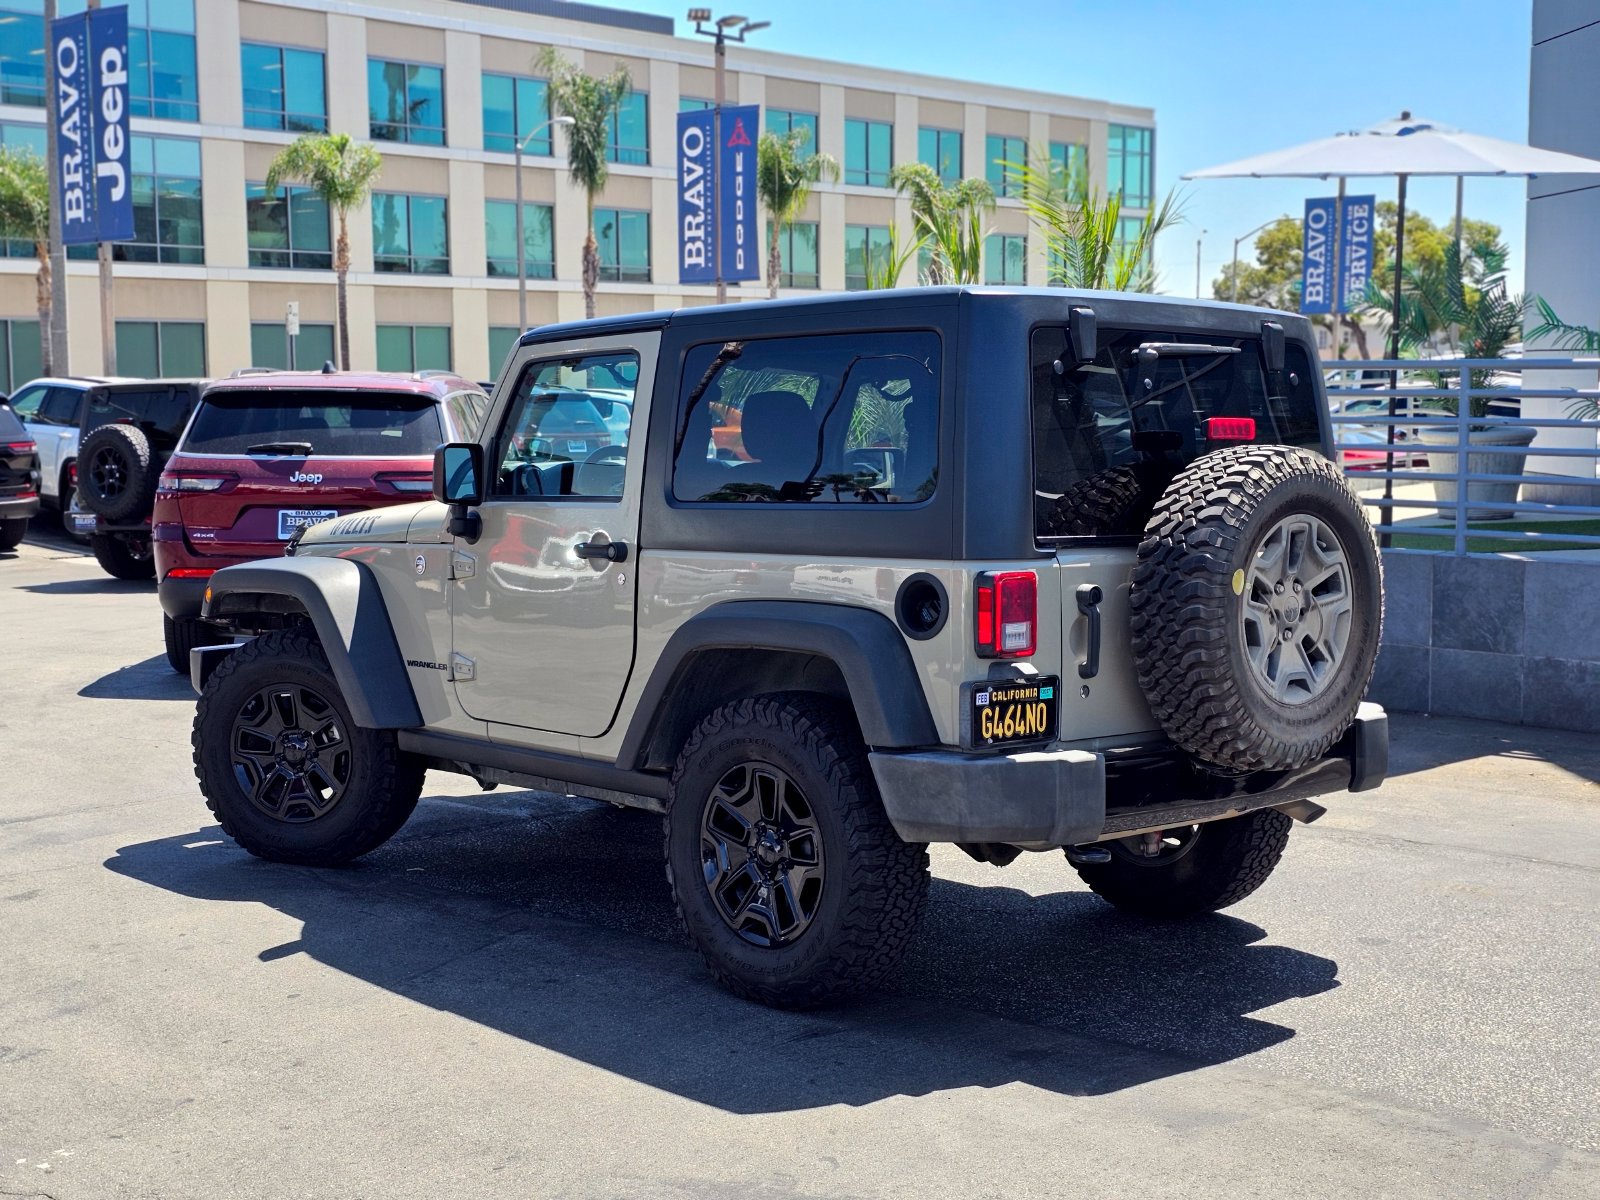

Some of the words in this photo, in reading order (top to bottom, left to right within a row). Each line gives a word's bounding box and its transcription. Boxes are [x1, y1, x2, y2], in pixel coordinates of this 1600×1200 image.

[57, 37, 85, 225] BRAVO
[97, 47, 127, 202] Jeep
[682, 126, 705, 269] BRAVO
[736, 151, 744, 270] DODGE
[1305, 208, 1328, 304] BRAVO
[290, 471, 323, 484] Jeep
[407, 659, 448, 671] WRANGLER
[977, 693, 988, 704] FEB
[992, 688, 1038, 702] CALIFORNIA
